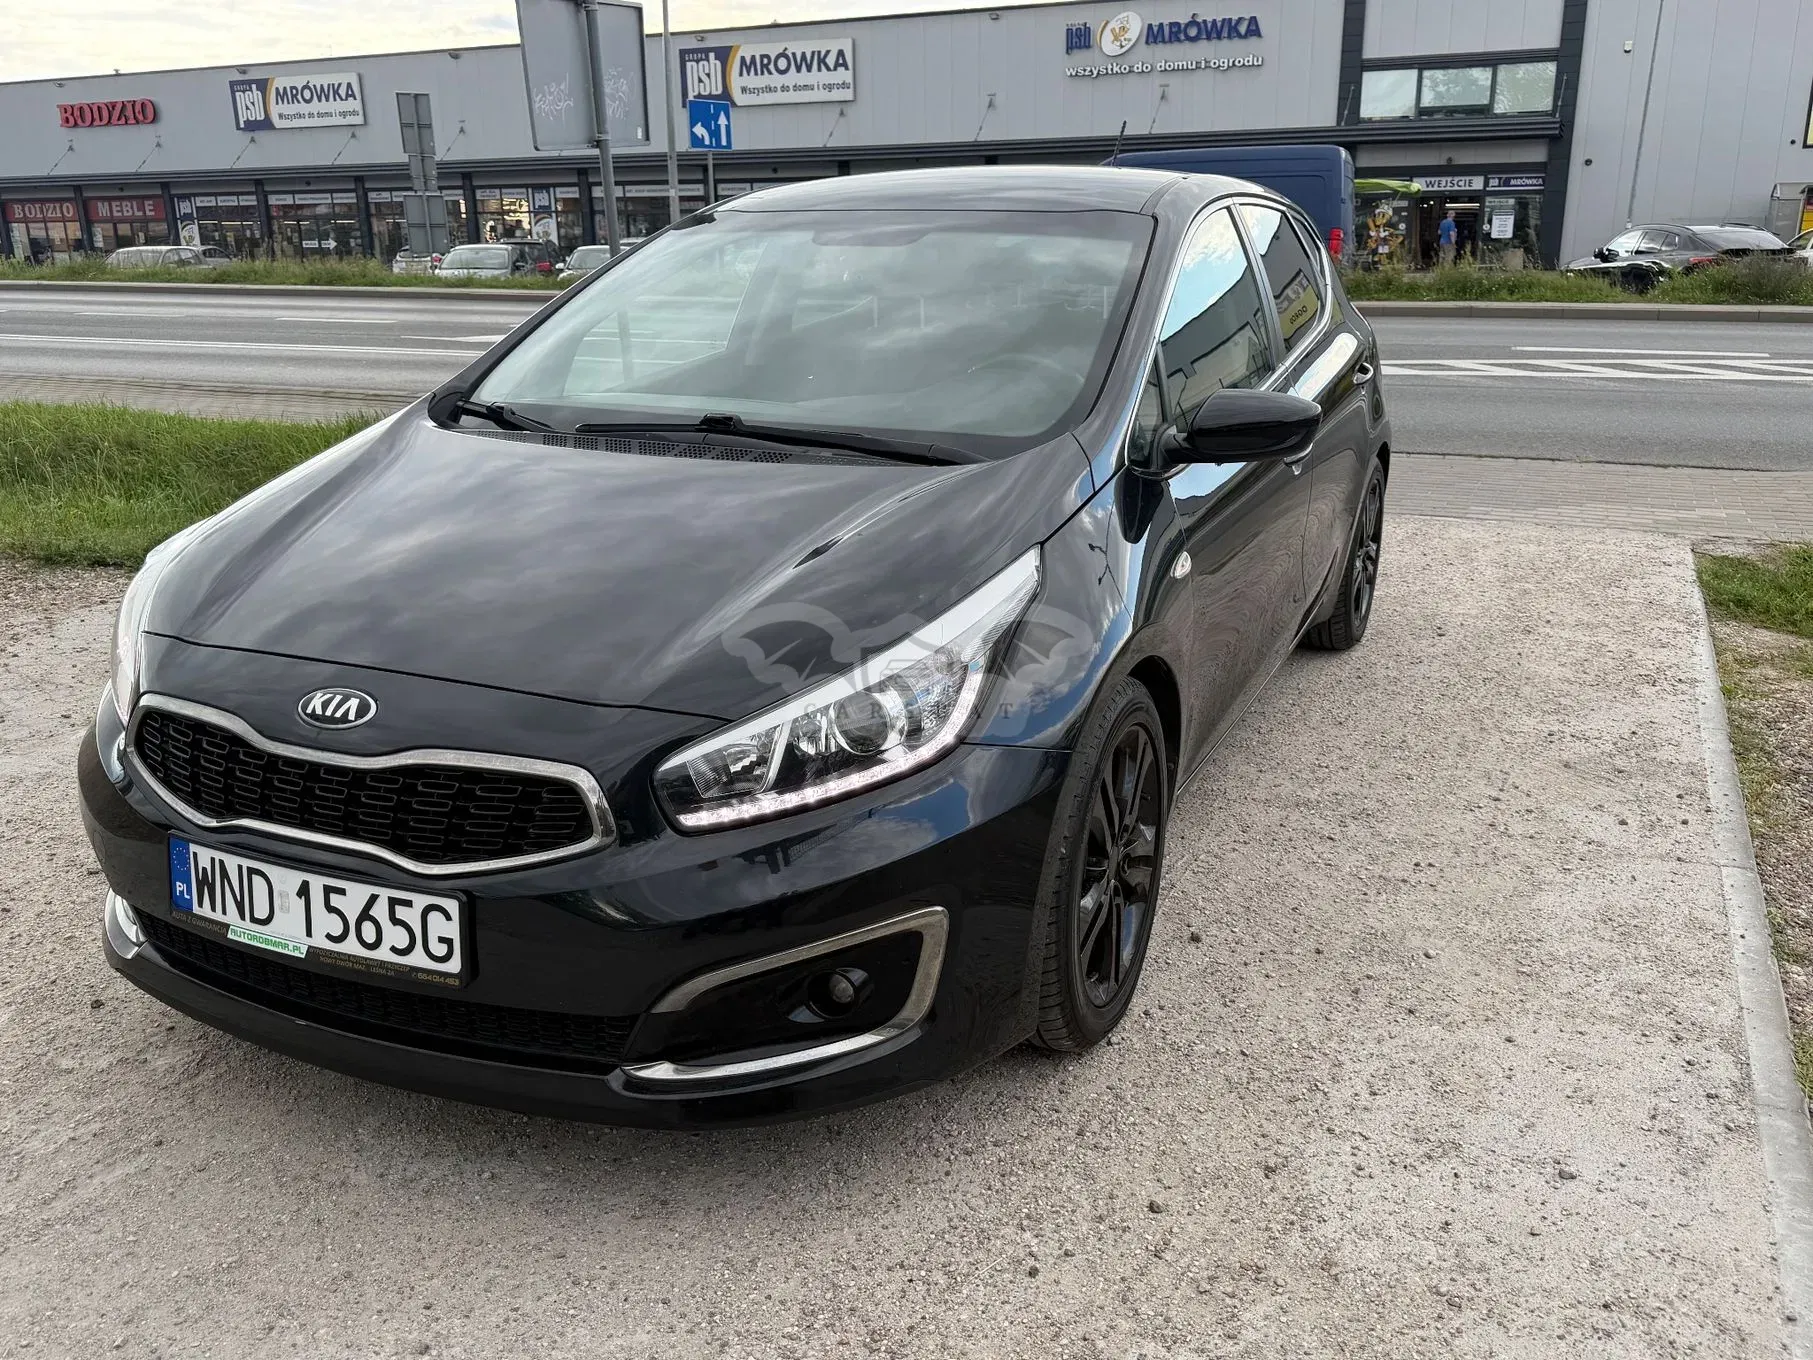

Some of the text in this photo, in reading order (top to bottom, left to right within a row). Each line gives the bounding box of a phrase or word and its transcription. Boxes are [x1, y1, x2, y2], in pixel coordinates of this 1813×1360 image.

[1065, 22, 1092, 55] psb
[1145, 12, 1263, 45] MRÓWKA
[738, 47, 850, 77] MRÓWKA
[1065, 54, 1263, 78] wszystko do domu i ogrodu
[685, 52, 723, 100] psb
[740, 85, 778, 96] Wszystko
[780, 83, 791, 93] do
[792, 82, 815, 93] domu
[822, 80, 851, 92] ogrodu
[235, 84, 265, 128] psb
[275, 80, 357, 106] MRÓWKA
[57, 98, 157, 128] BODZIO
[278, 111, 306, 122] Wszystko
[307, 111, 316, 119] do
[316, 110, 333, 119] domu
[338, 108, 360, 119] ogrodu
[1424, 177, 1474, 189] WEJŚCIE
[1509, 176, 1544, 186] MRÓWKA
[12, 202, 74, 219] BODZIO
[97, 200, 156, 217] MEBLE
[306, 692, 360, 721] KIA
[175, 881, 191, 900] PL
[193, 851, 454, 964] WND 1565G
[230, 928, 305, 955] AUTOROBMAR.PL
